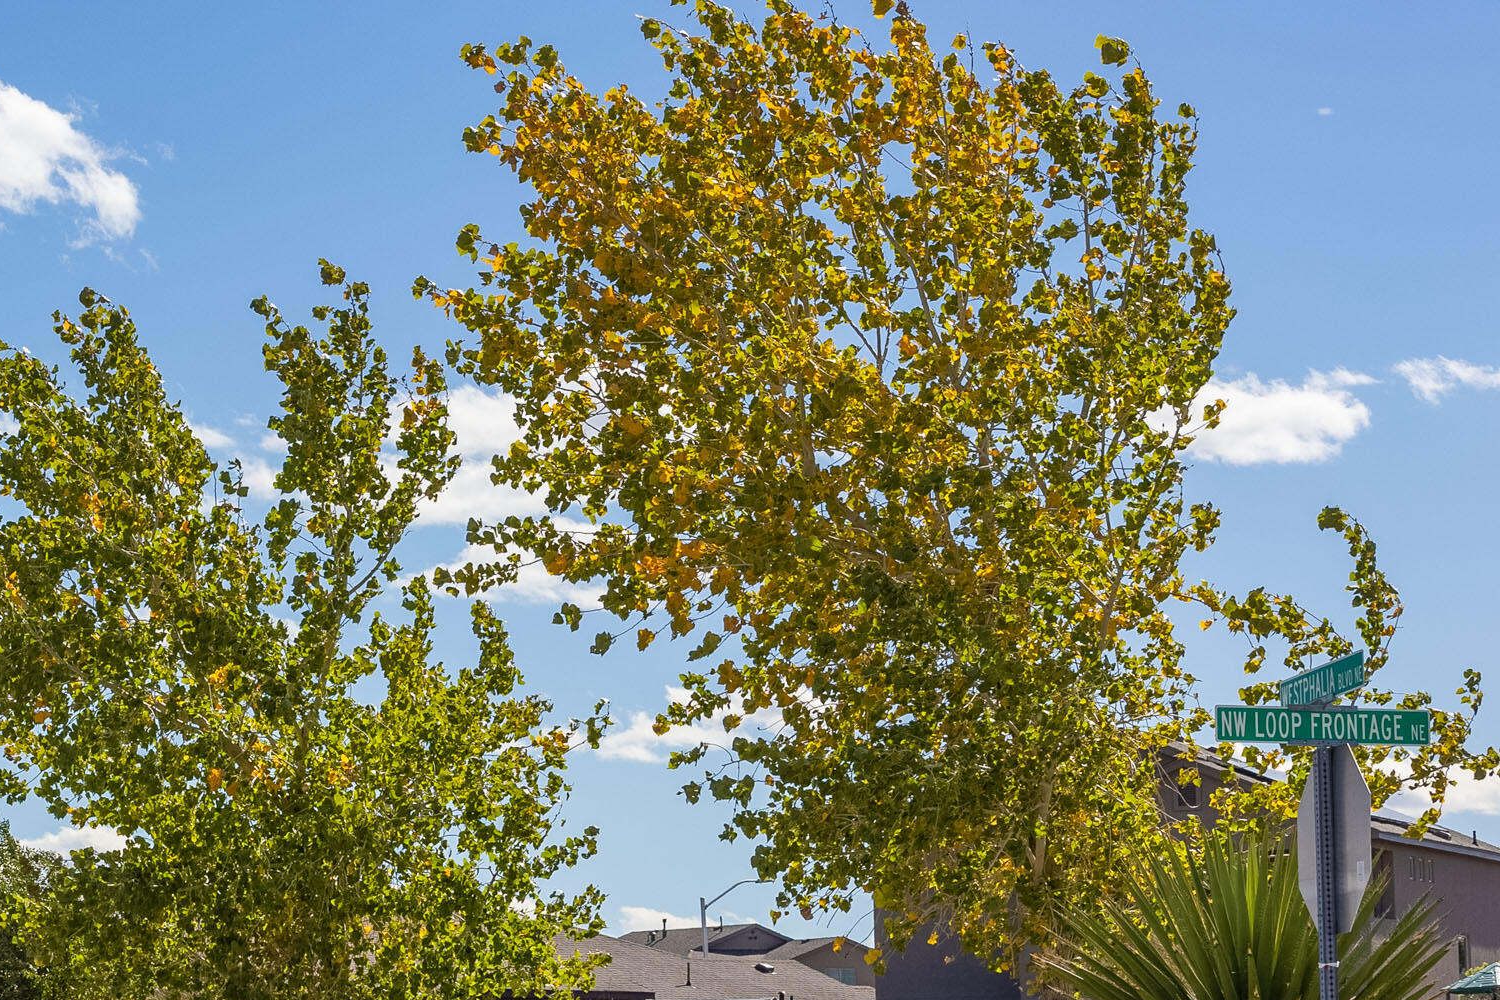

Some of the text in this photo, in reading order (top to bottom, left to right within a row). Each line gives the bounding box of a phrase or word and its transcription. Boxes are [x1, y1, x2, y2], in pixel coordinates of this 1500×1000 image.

[1282, 664, 1363, 706] WESTPHALIA BLVD NE
[1221, 711, 1426, 741] NW LOOP FRONTAGE NE
